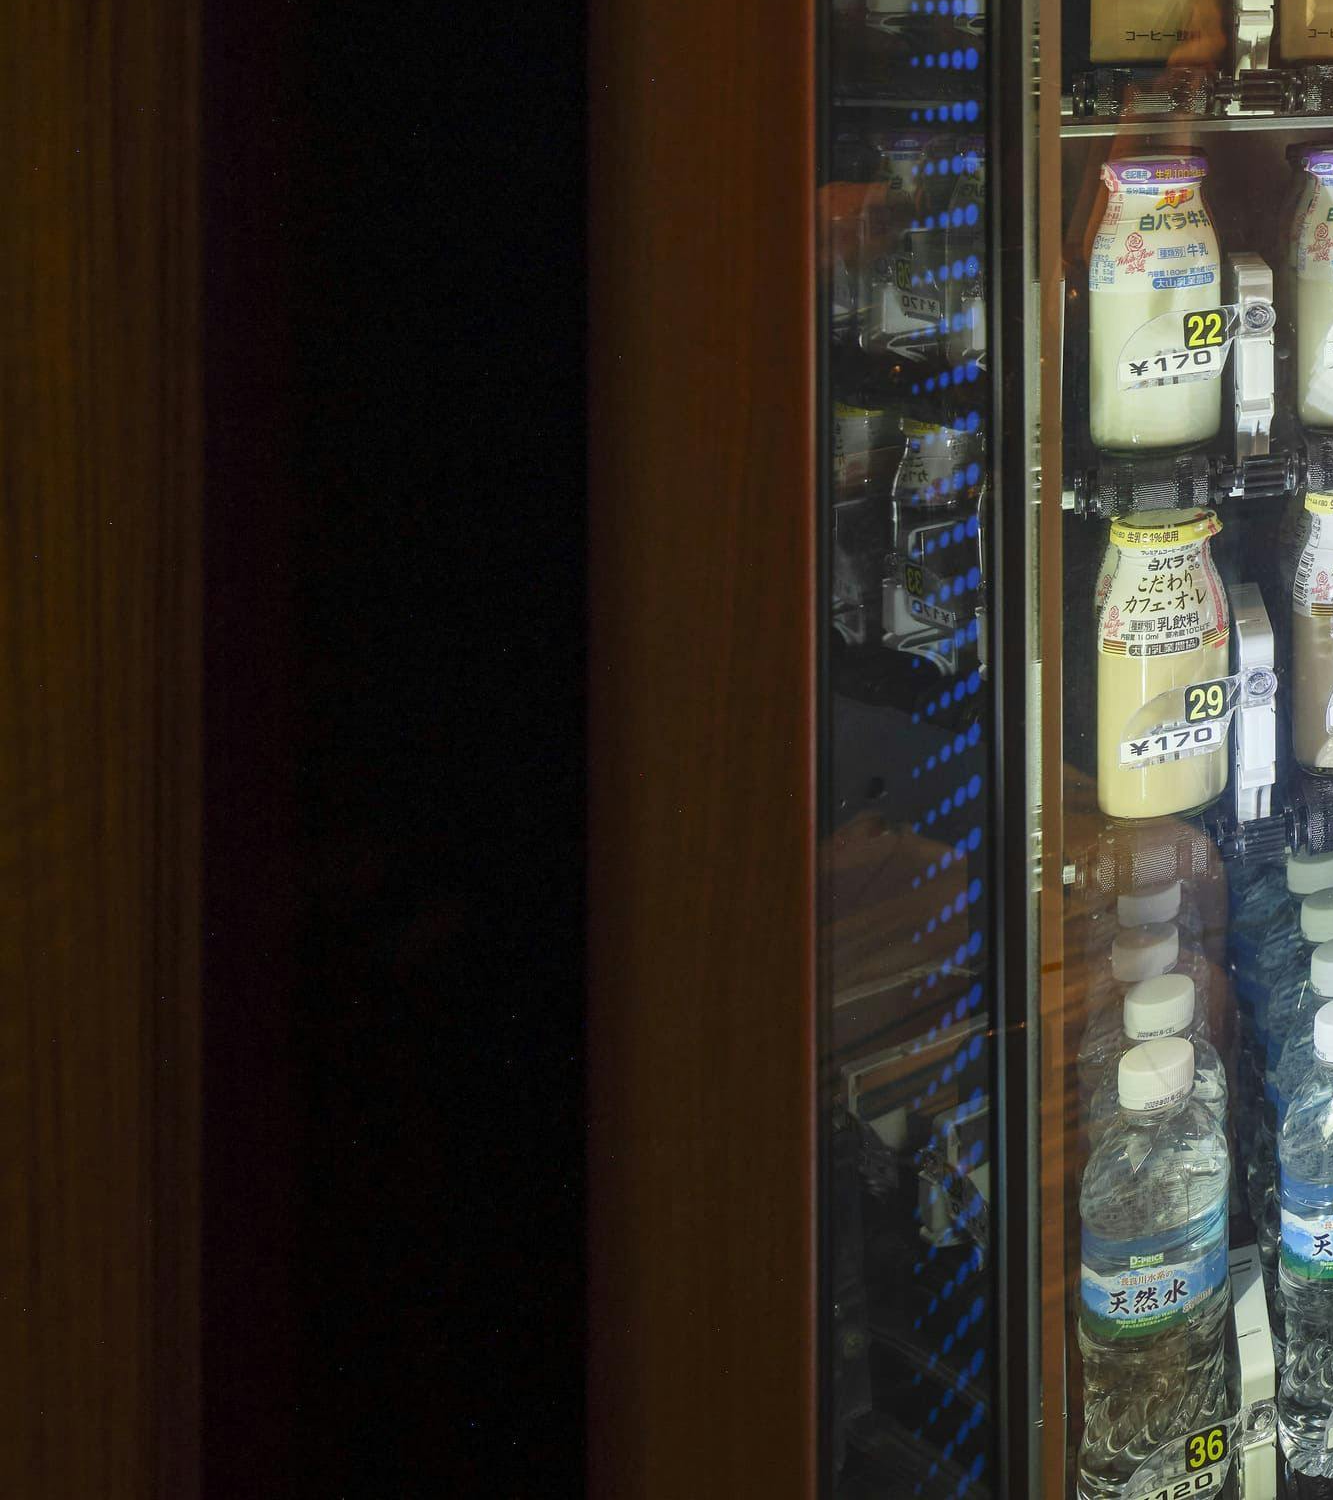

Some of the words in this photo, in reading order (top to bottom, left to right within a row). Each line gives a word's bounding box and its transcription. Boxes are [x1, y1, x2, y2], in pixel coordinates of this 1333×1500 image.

[1187, 313, 1223, 348] 22
[1128, 350, 1212, 376] ¥170
[1138, 570, 1193, 594] こだわり
[1122, 589, 1207, 615] カフェ・オ・レ
[1157, 611, 1200, 632] 乳飲料
[1189, 687, 1223, 720] 29
[1130, 728, 1212, 756] ¥170
[1109, 1279, 1188, 1315] 天然水
[1189, 1429, 1223, 1468] 36
